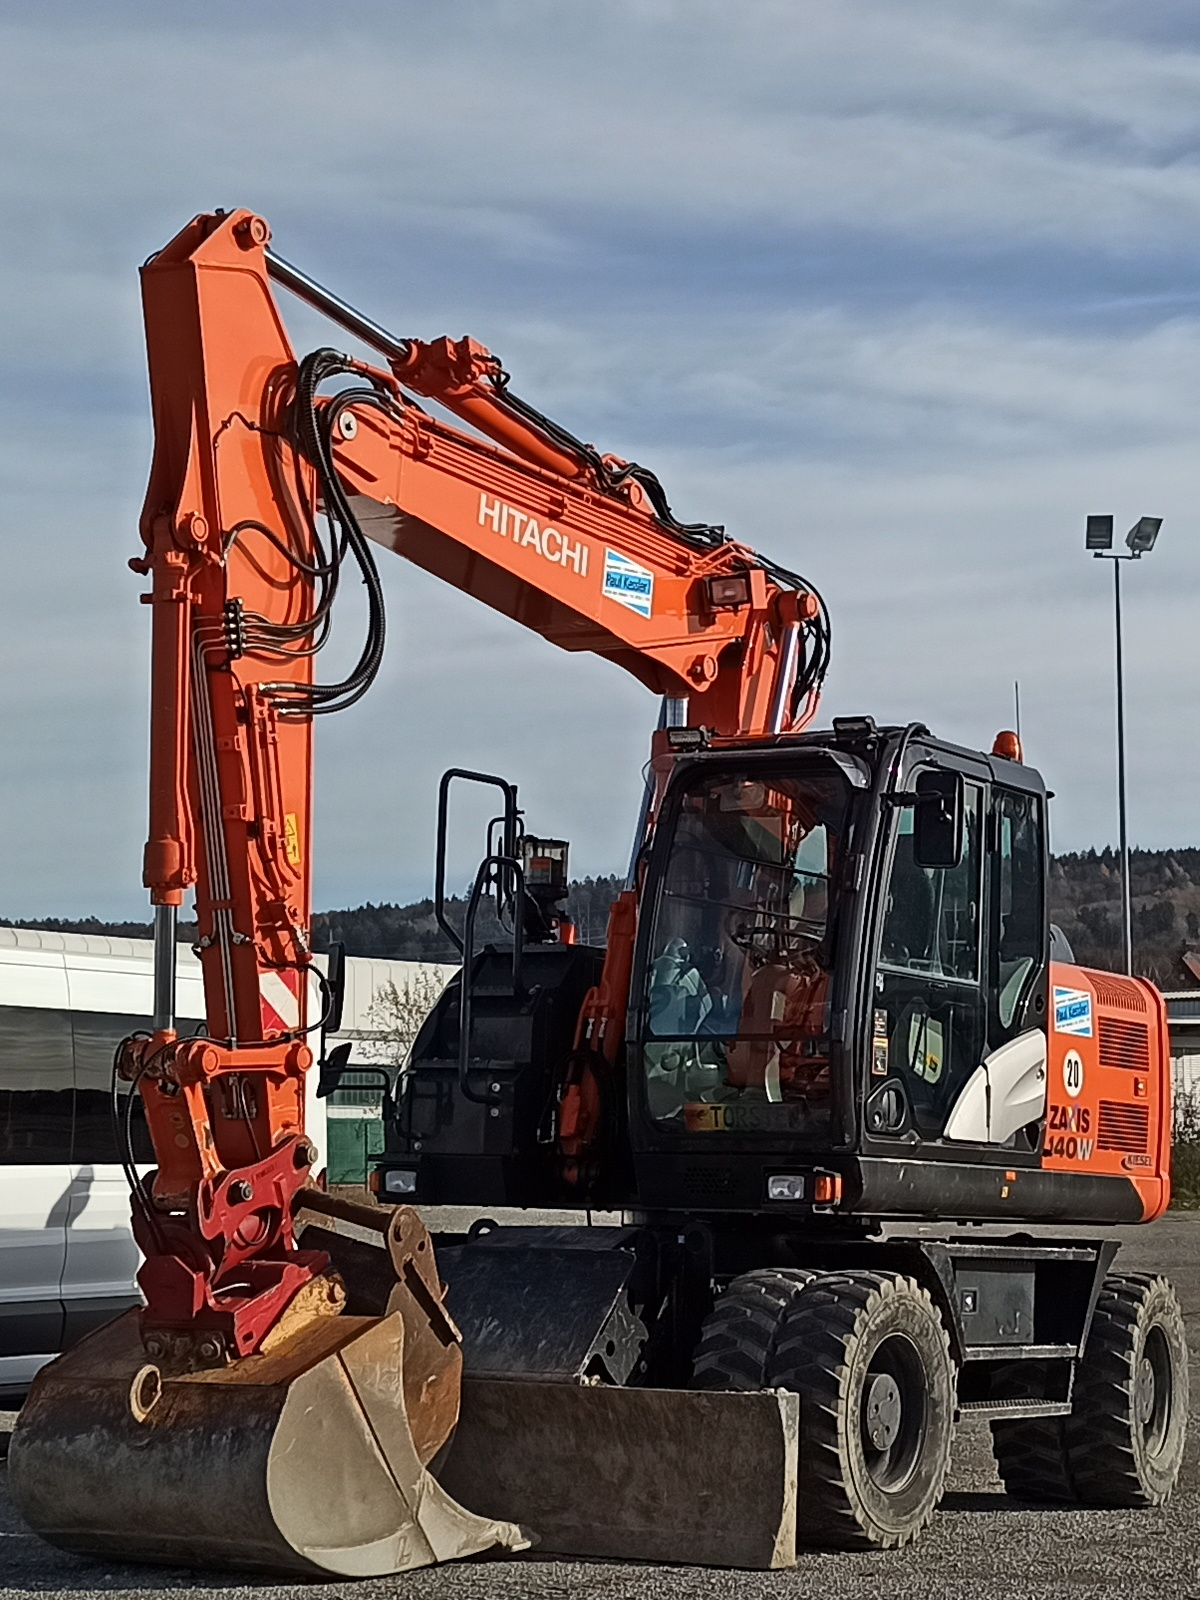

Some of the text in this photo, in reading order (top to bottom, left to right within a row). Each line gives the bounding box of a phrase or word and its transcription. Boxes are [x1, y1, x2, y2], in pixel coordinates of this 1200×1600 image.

[478, 492, 589, 578] HITACHI
[605, 572, 649, 594] Paul Kessler
[1056, 1006, 1069, 1023] Paul
[1067, 1059, 1079, 1089] 20
[1049, 1104, 1090, 1133] ZAXIS
[1048, 1136, 1094, 1160] 140W
[1127, 1154, 1153, 1167] KIESEL
